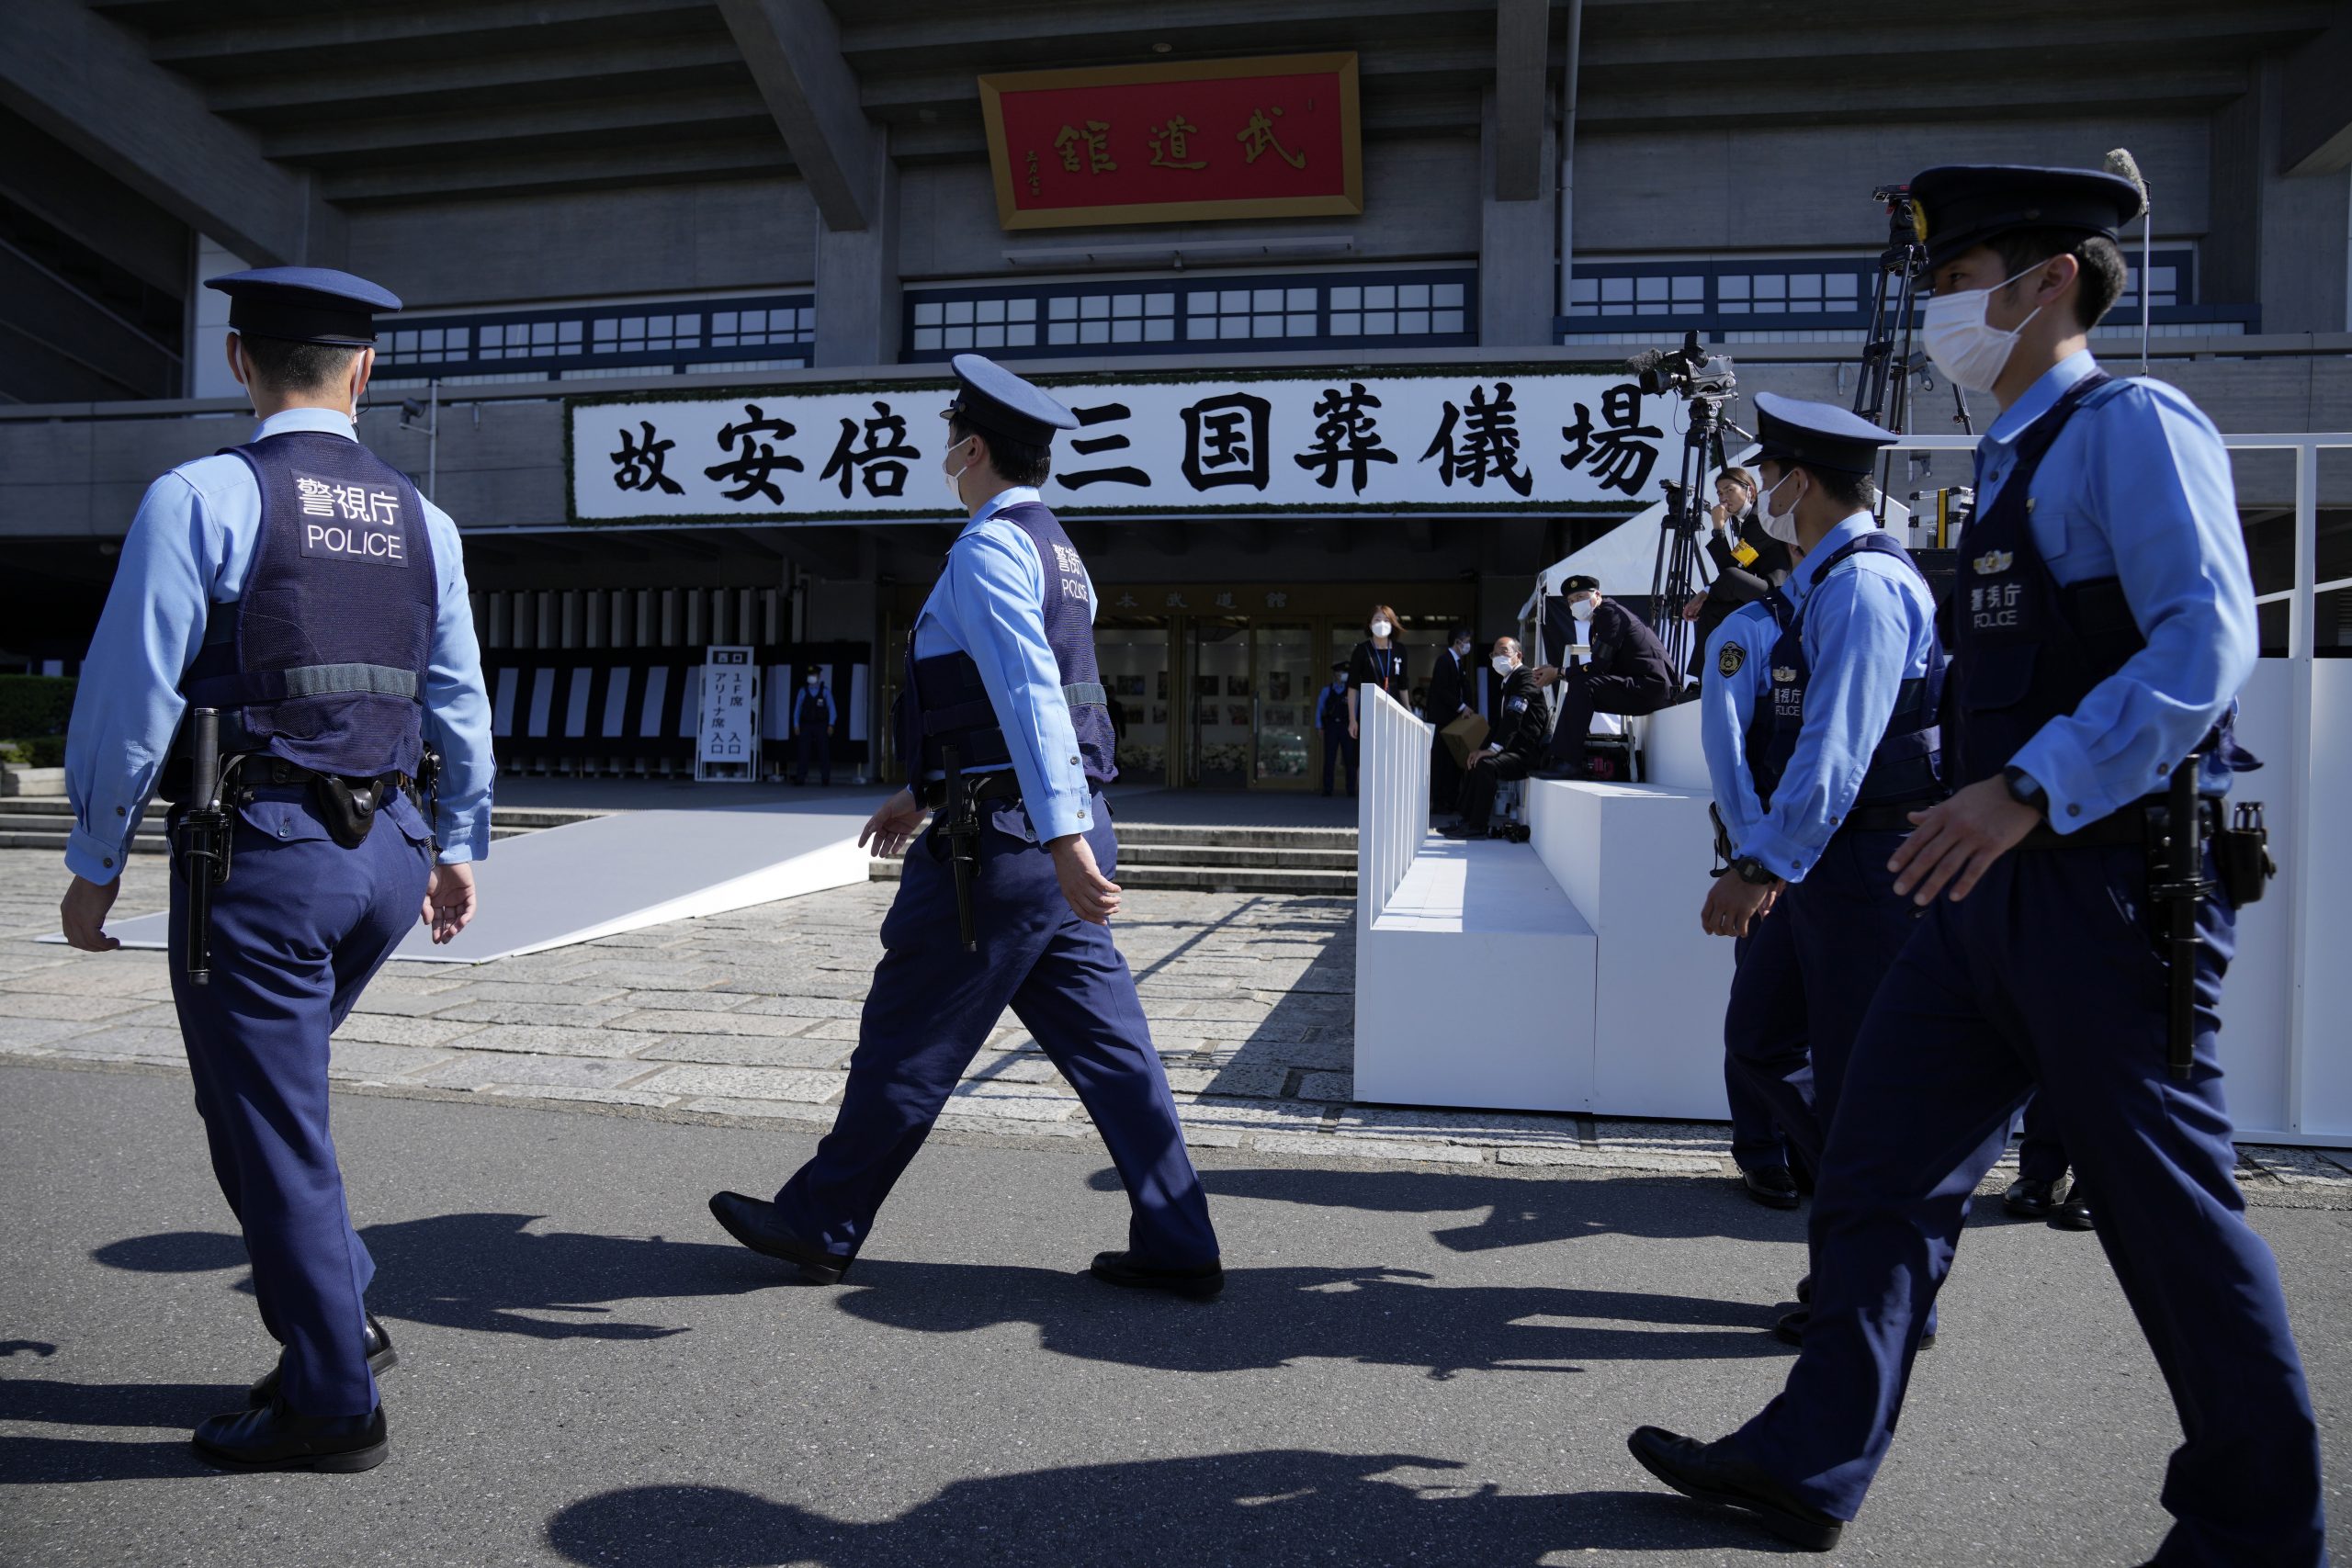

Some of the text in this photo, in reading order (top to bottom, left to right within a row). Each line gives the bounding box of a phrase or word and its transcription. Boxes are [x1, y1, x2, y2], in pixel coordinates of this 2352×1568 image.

[609, 382, 1665, 505] 故安倍三国葬儀場
[297, 478, 399, 525] 警視庁
[307, 525, 402, 559] POLICE
